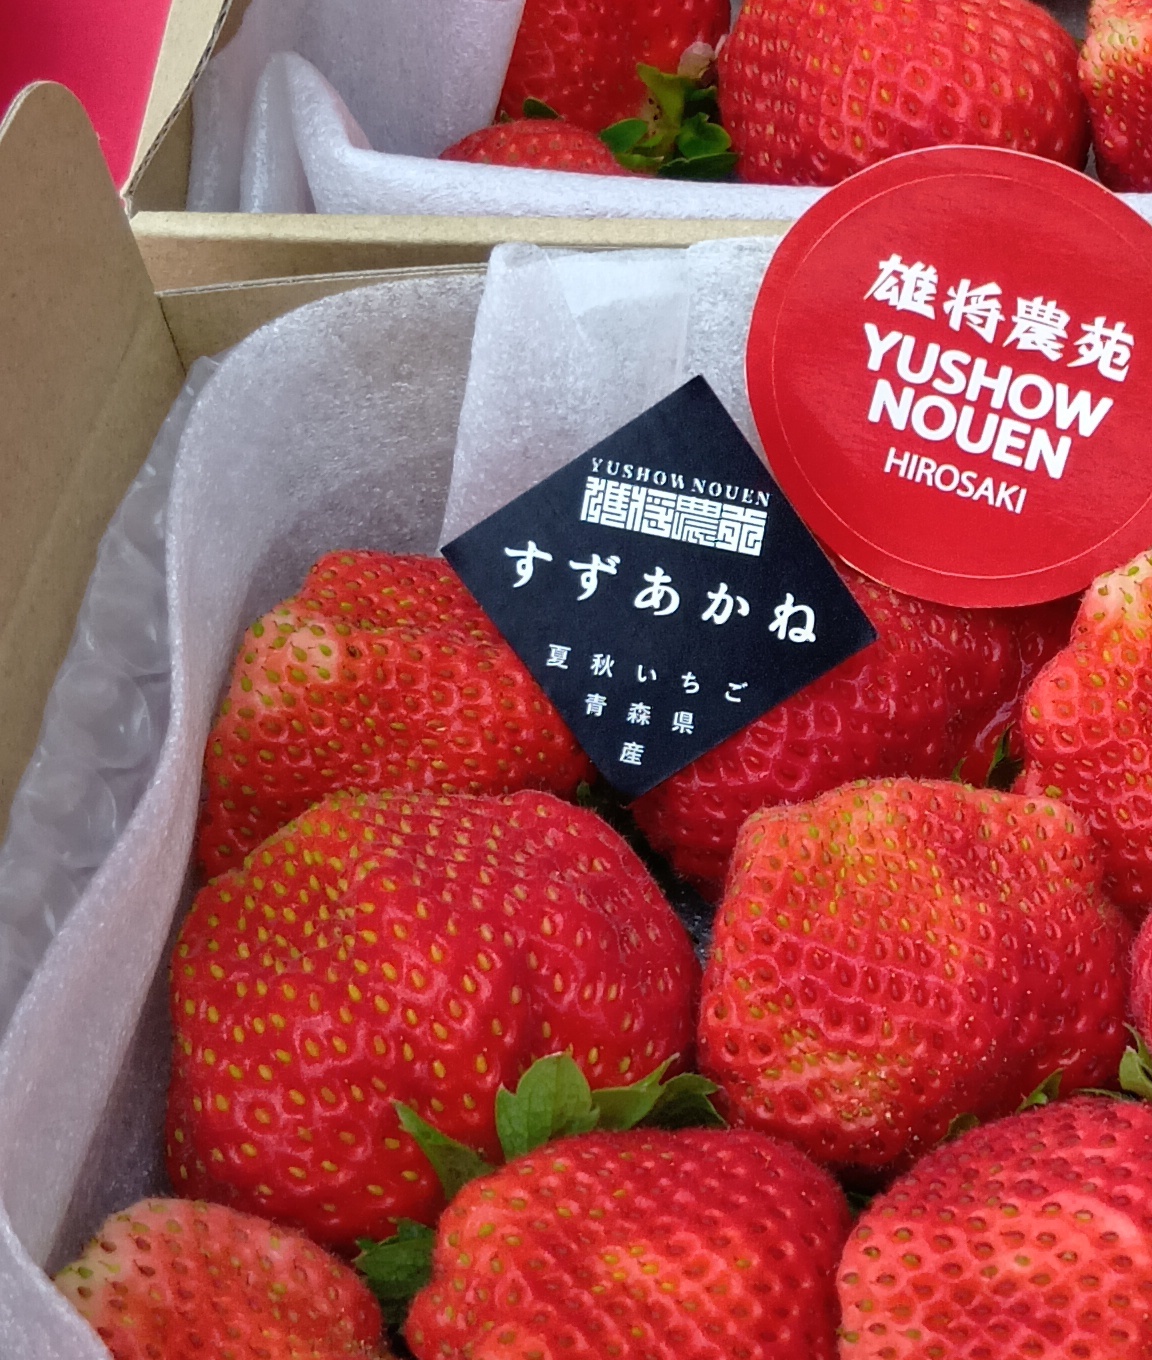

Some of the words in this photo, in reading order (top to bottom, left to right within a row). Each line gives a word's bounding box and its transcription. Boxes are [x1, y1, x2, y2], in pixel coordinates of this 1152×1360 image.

[863, 253, 1135, 382] 雄将農苑
[863, 323, 1113, 438] YUSHOW
[867, 380, 1073, 479] NOUEN
[591, 456, 686, 490] YUSHOW
[691, 477, 773, 508] NOUEN
[884, 446, 1028, 514] HIROSAKI
[504, 540, 817, 643] すずあかね
[546, 643, 749, 704] 夏秋いちご
[584, 692, 695, 735] 青森県
[619, 741, 646, 766] 産
